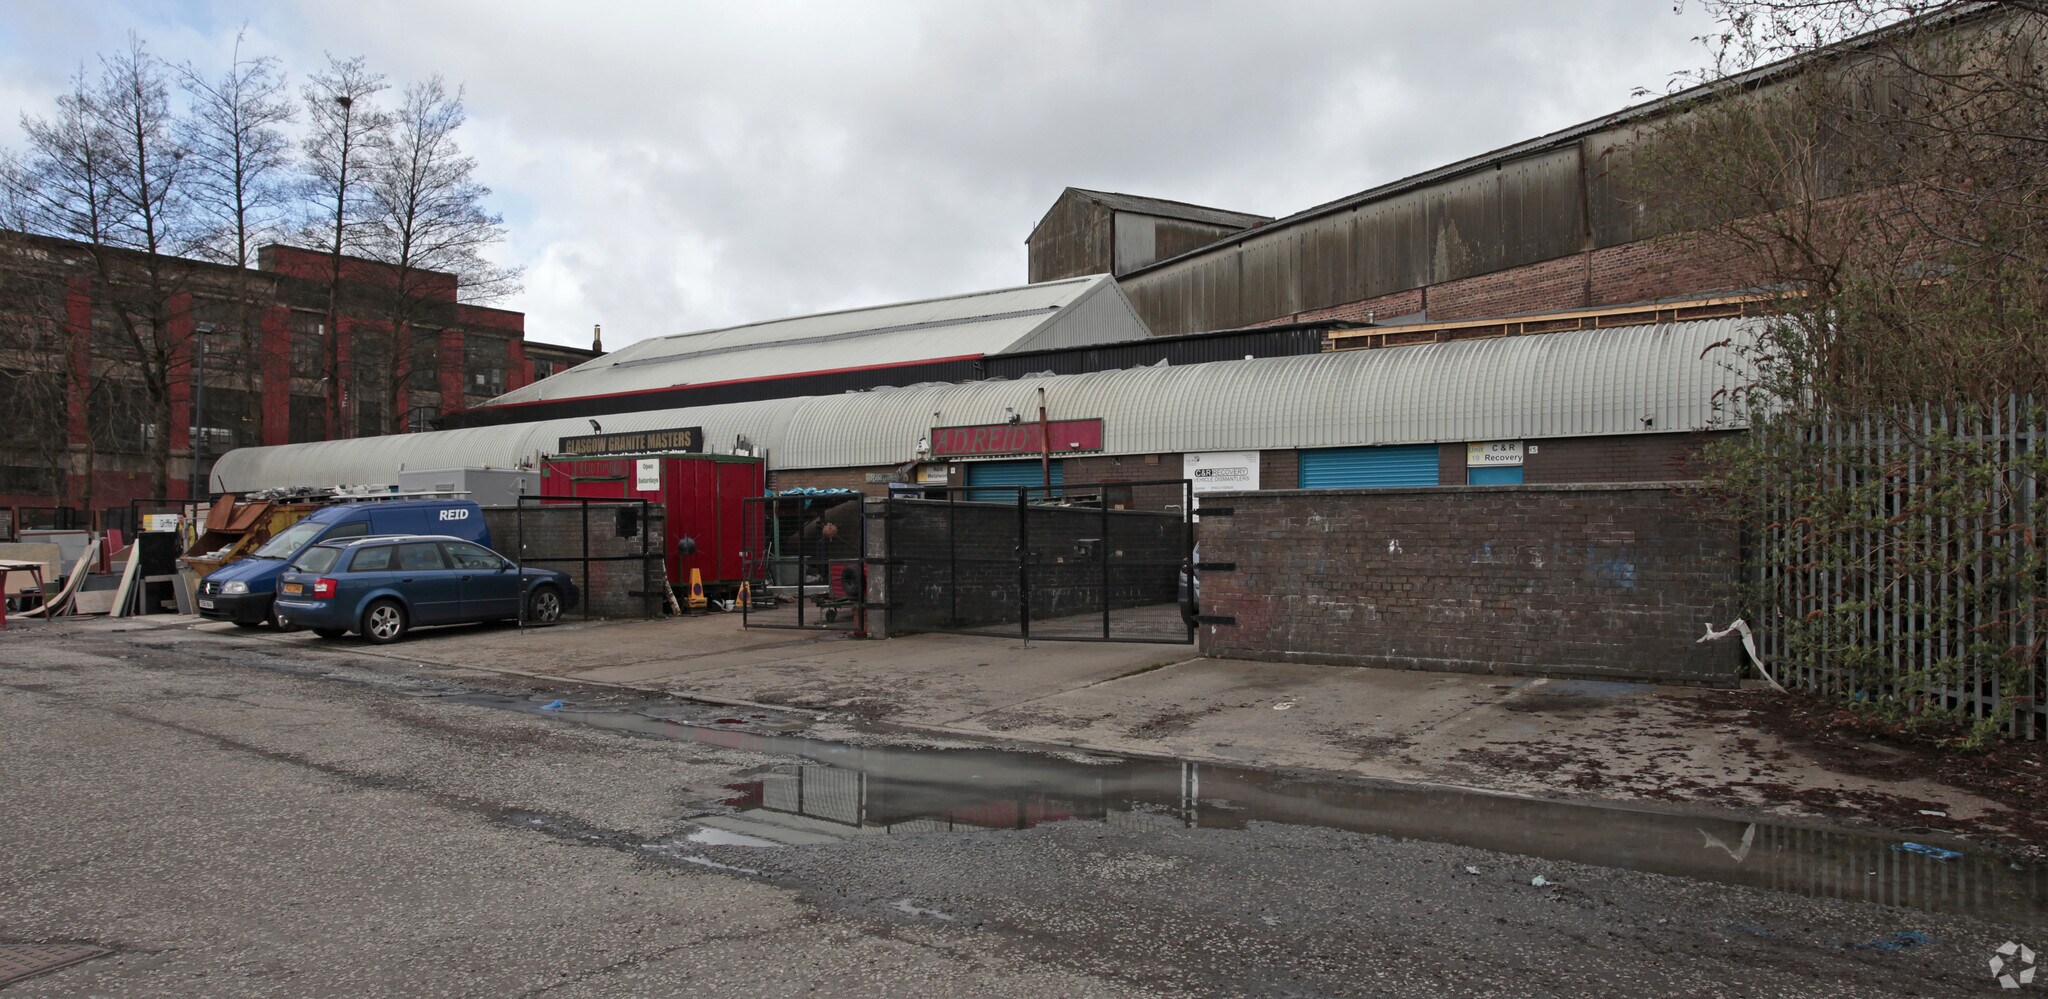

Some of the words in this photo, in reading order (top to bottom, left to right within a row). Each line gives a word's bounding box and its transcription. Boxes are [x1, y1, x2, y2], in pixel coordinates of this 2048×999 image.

[565, 438, 607, 454] GLASGOW
[608, 435, 645, 451] GRANITE
[647, 431, 691, 447] MASTERS
[971, 426, 1029, 452] REID
[1509, 443, 1515, 451] R
[1485, 454, 1523, 462] Recovery
[643, 463, 654, 471] Open
[1212, 468, 1246, 476] RECOVERY
[439, 508, 469, 521] REID
